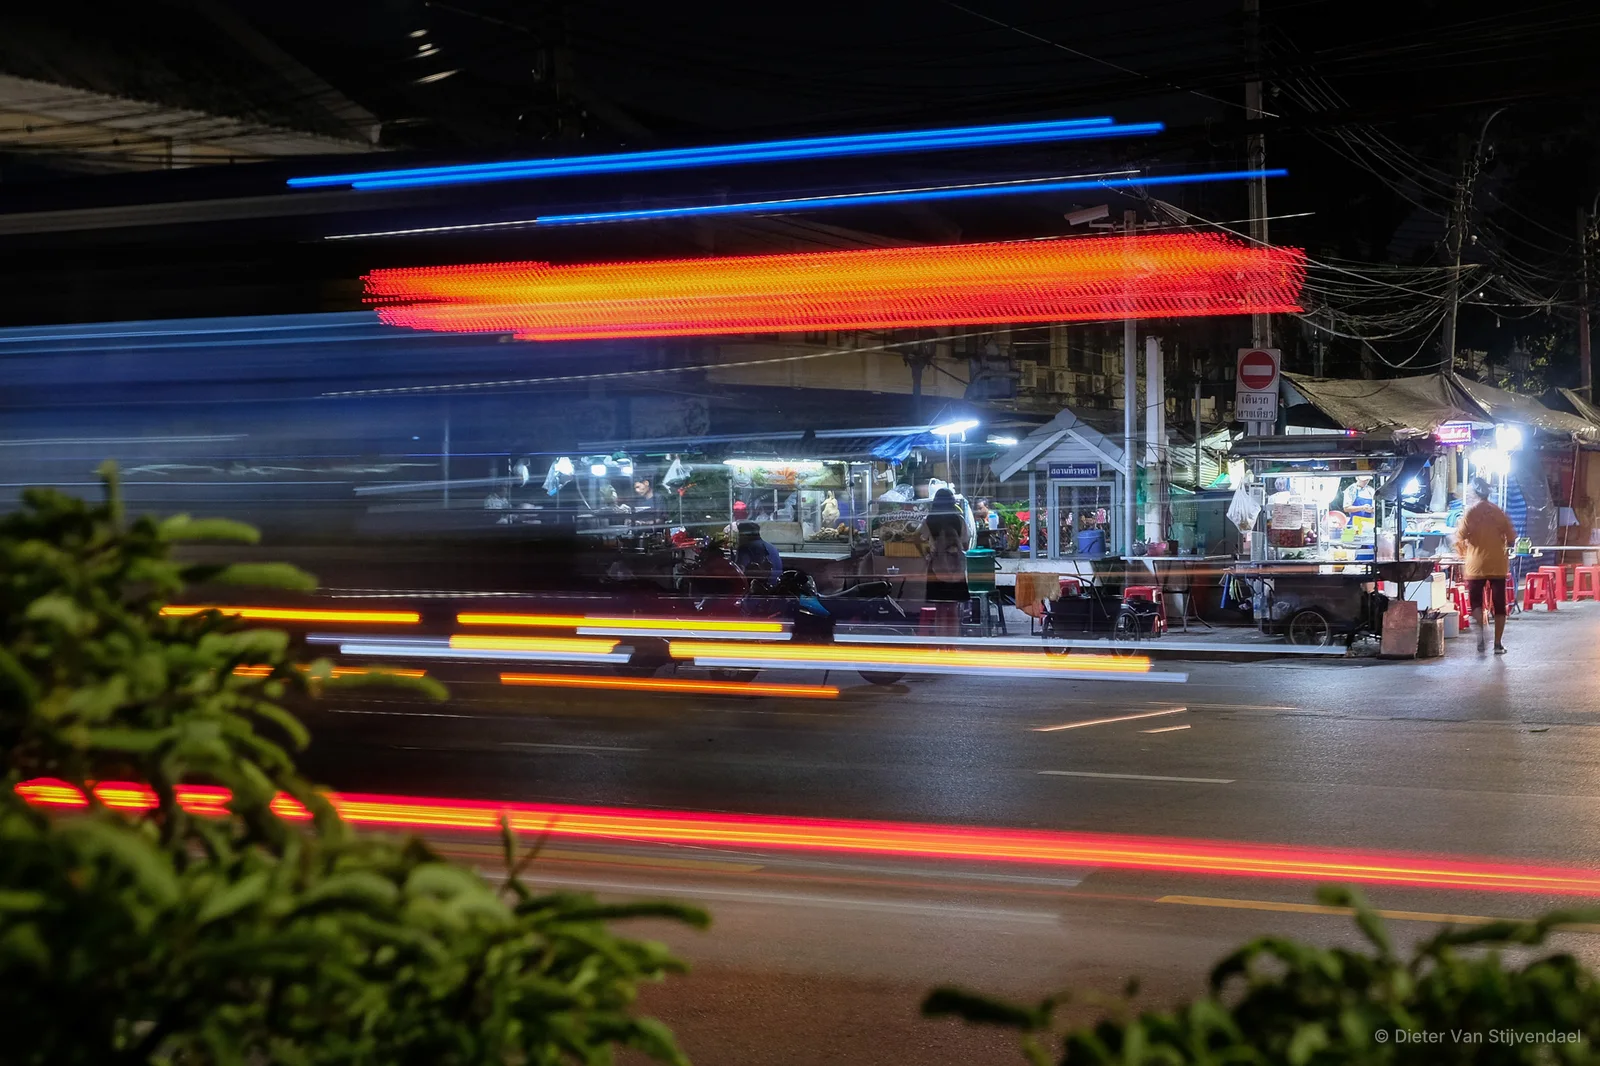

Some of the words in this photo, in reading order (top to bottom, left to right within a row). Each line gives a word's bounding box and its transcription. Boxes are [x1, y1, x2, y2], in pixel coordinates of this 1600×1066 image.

[1238, 408, 1273, 418] ทางเดียว
[1051, 464, 1096, 475] สถานที่ราชการ
